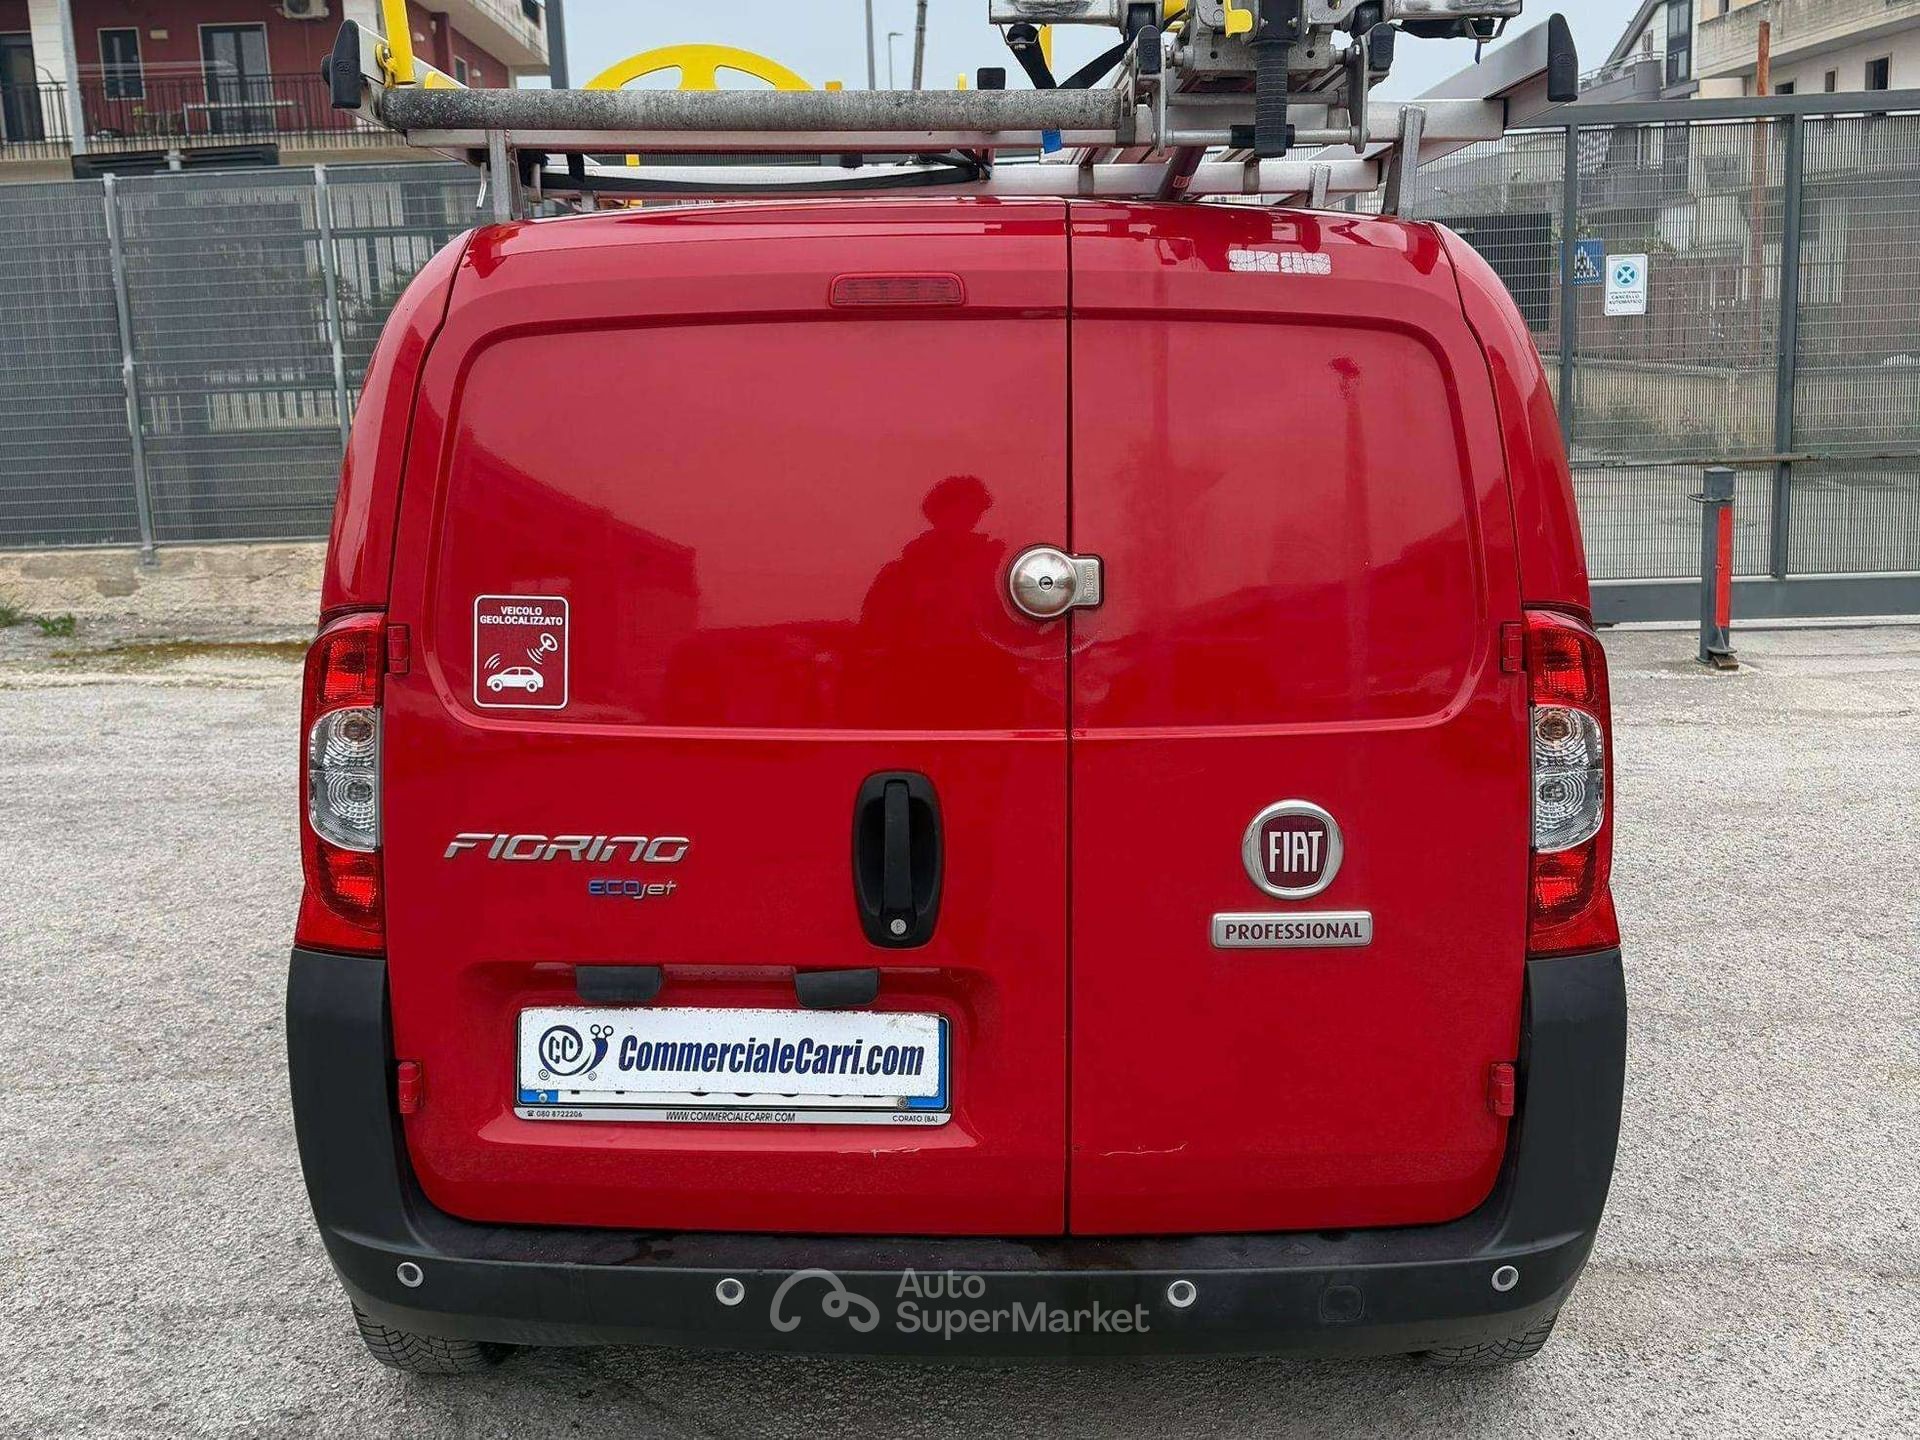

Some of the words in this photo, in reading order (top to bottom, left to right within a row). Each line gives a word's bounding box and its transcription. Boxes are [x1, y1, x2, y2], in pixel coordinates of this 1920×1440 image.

[501, 606, 542, 616] VEICOLO
[480, 615, 563, 626] GEOLOCALIZZATO
[1269, 831, 1323, 873] FIAT
[588, 880, 677, 900] ECOjet
[1225, 922, 1362, 940] PROFESSIONAL
[618, 1034, 925, 1076] CommercialeCarri.com
[551, 1110, 583, 1118] 8722206
[892, 1114, 923, 1122] CORATO
